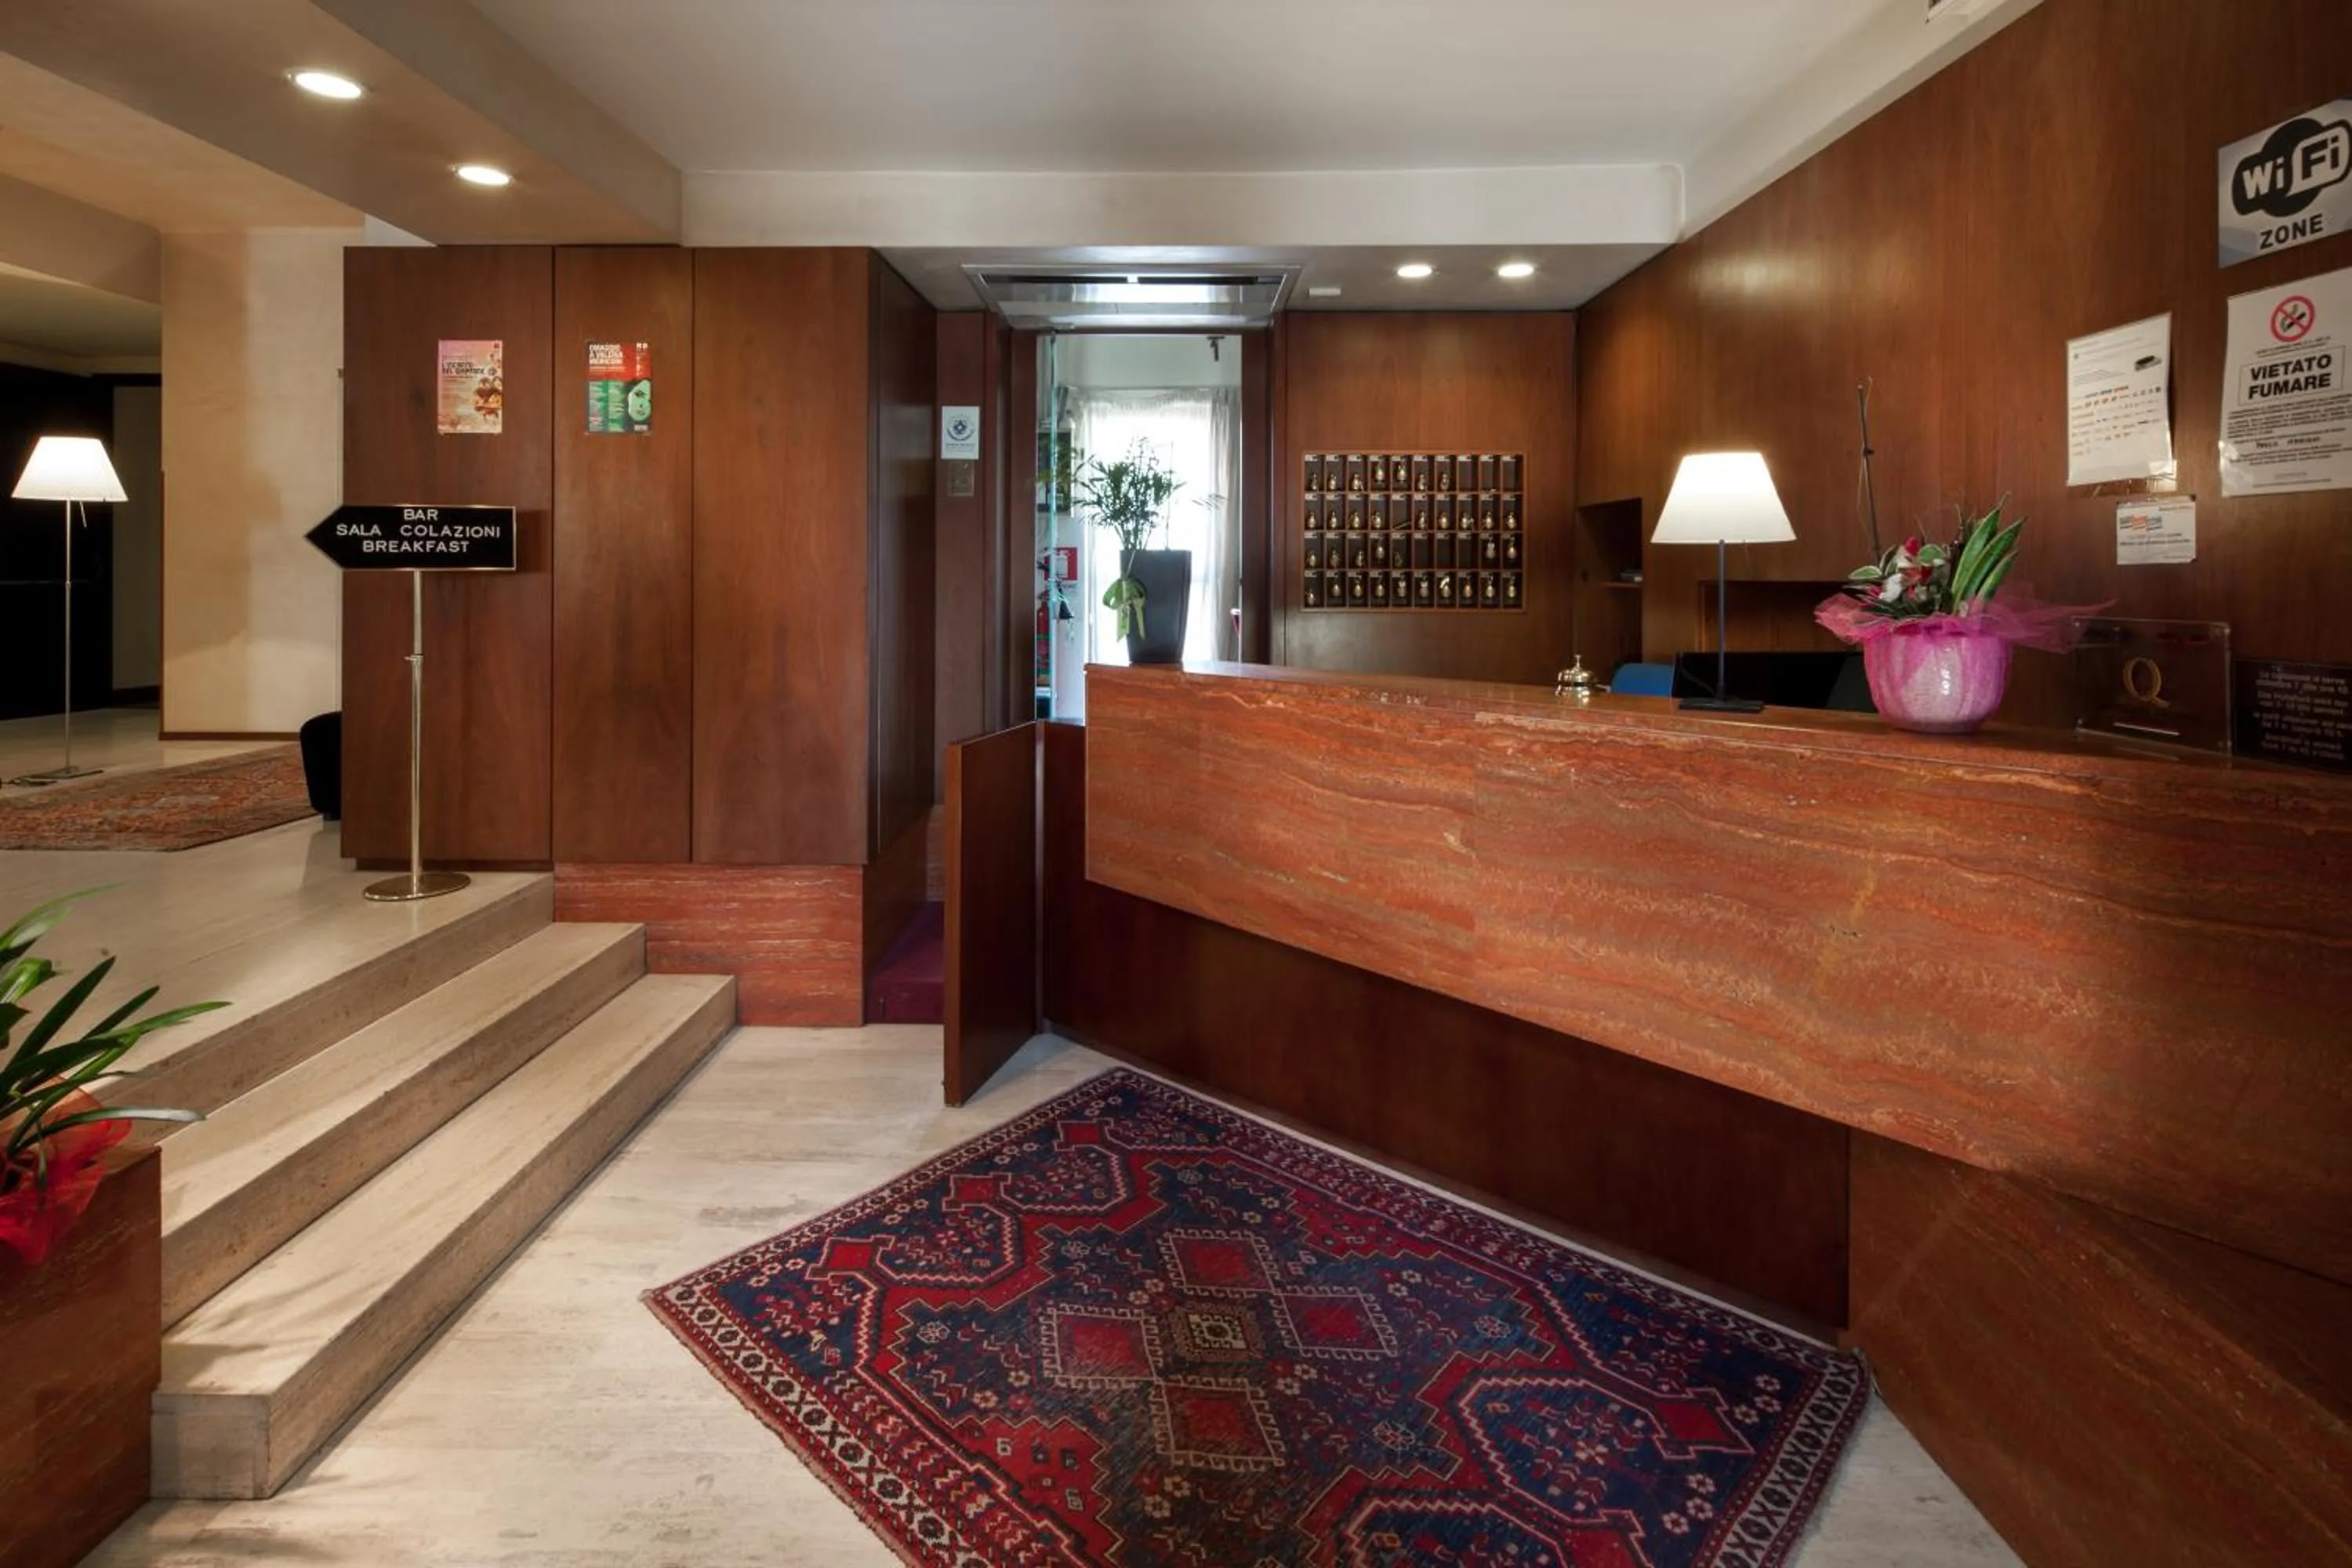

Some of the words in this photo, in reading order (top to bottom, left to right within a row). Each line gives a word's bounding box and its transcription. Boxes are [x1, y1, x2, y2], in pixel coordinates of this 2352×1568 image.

[2259, 213, 2323, 249] ZONE
[2251, 354, 2332, 381] VIETATO
[2248, 372, 2332, 400] FUMARE
[404, 509, 438, 521] BAR
[336, 524, 382, 536] SALA
[400, 524, 501, 538] COLAZIONI
[362, 540, 470, 553] BREAKFAST
